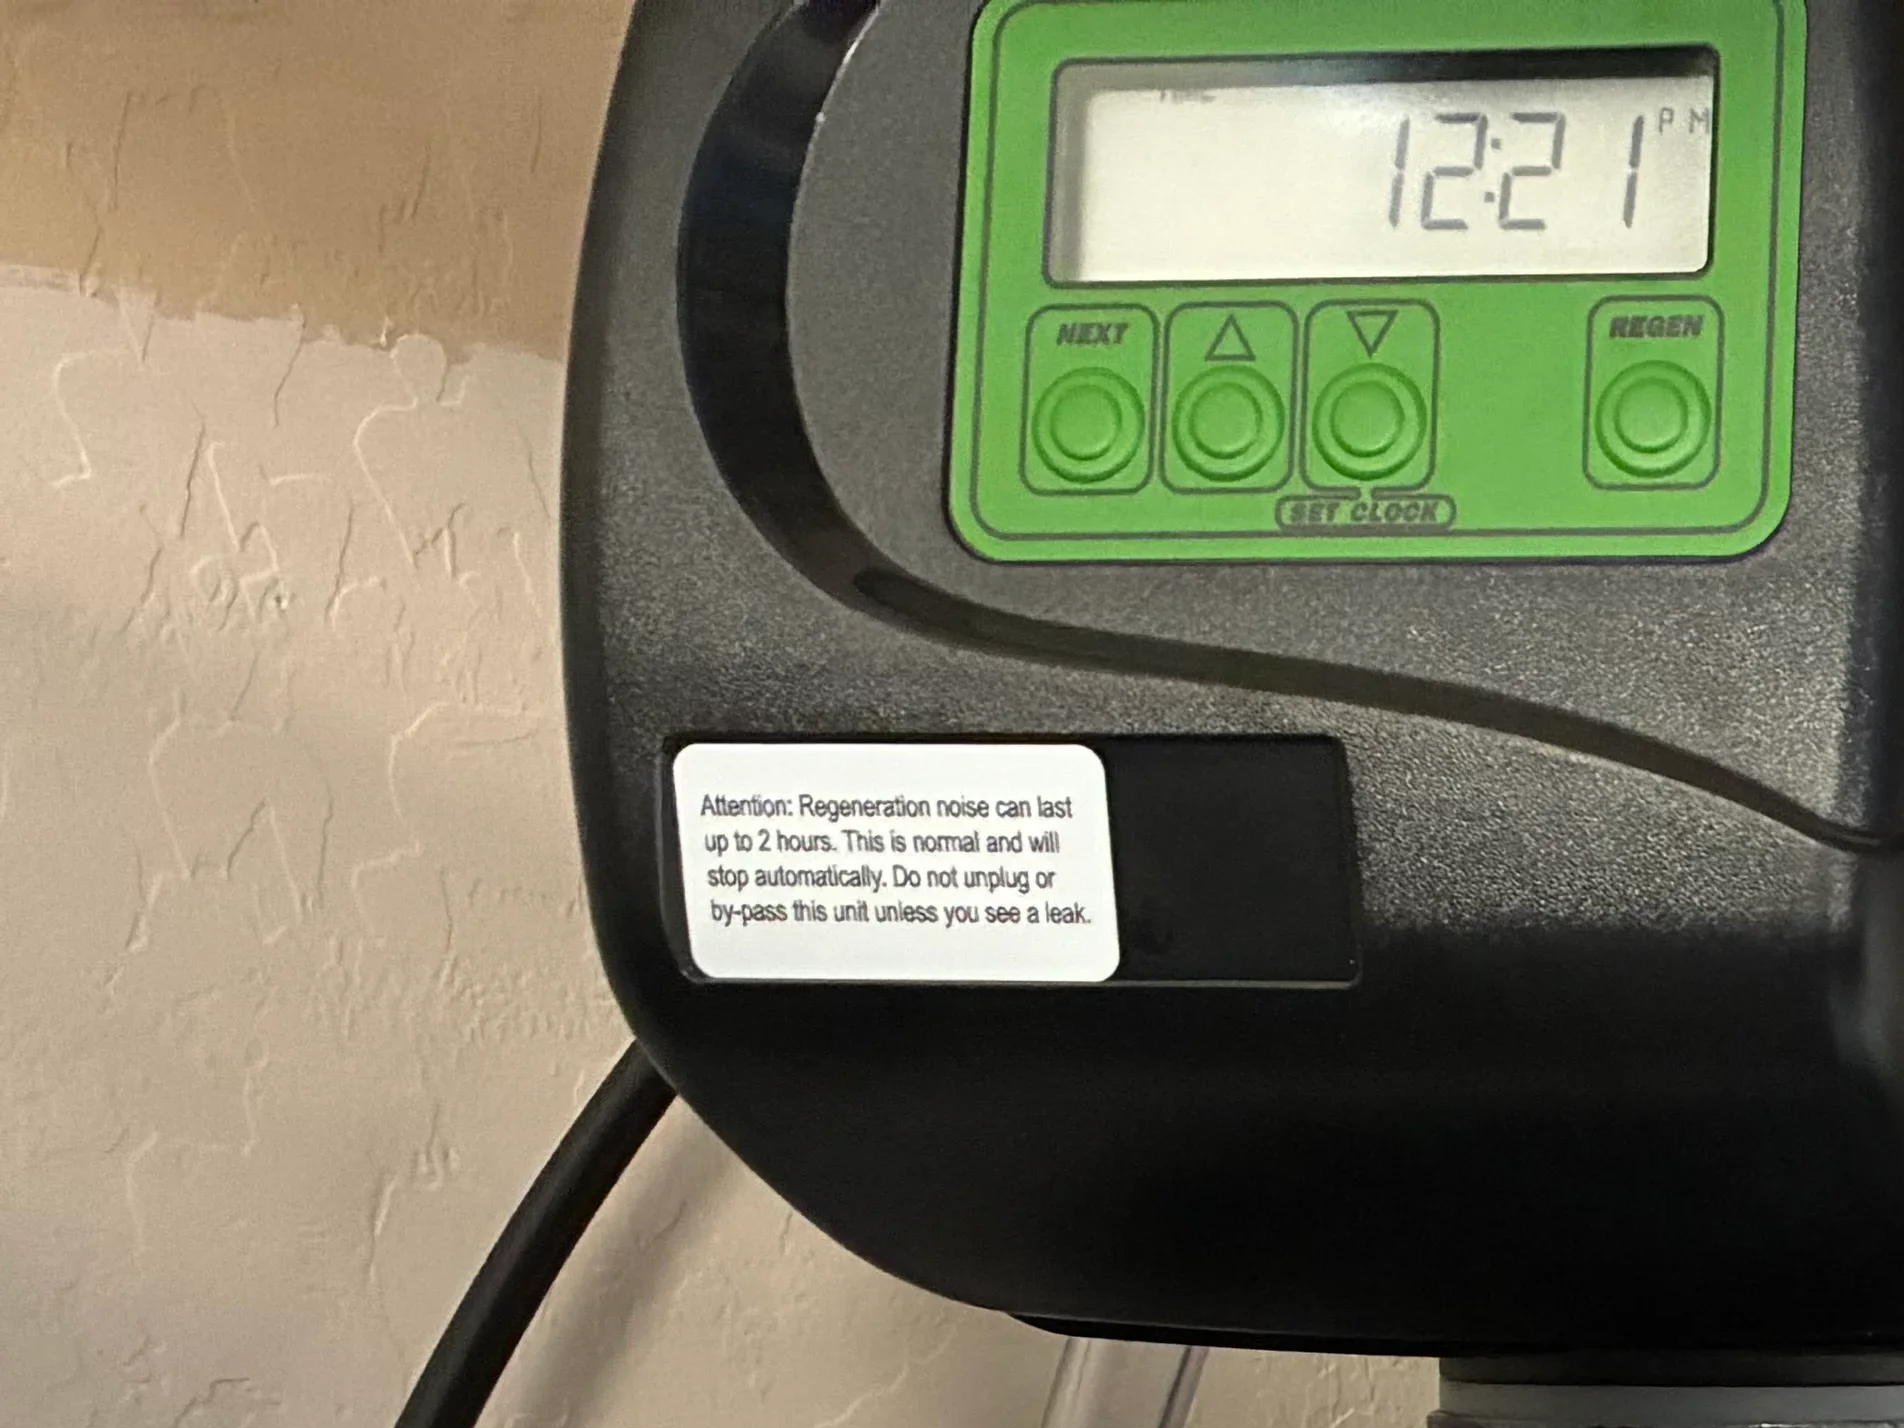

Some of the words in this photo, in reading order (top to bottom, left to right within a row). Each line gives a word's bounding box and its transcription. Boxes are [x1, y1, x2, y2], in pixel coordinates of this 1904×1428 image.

[1389, 111, 1644, 230] 12:21
[1659, 107, 1709, 135] PM
[1056, 322, 1127, 345] NEXT
[1609, 314, 1704, 338] REGEN
[1289, 501, 1341, 524] SET
[1350, 500, 1439, 523] CLOCK
[701, 794, 792, 817] Attention:
[800, 796, 931, 822] Regeneration
[937, 798, 988, 818] noise
[995, 800, 1031, 818] can
[1038, 797, 1072, 819] last
[705, 835, 729, 855] up
[735, 831, 753, 852] to
[758, 831, 771, 852] 2
[777, 830, 836, 852] hours.
[845, 830, 885, 852] This
[891, 832, 907, 852] is
[913, 831, 980, 853] normal
[986, 832, 1022, 853] and
[1029, 832, 1060, 853] will
[708, 868, 749, 891] stop
[754, 865, 888, 892] automatically.
[893, 866, 920, 886] Do
[927, 867, 958, 888] not
[964, 866, 1029, 893] unplug
[1036, 871, 1055, 888] or
[711, 900, 787, 927] by-pass
[793, 901, 828, 923] this
[834, 901, 869, 923] unit
[875, 902, 938, 923] unless
[944, 905, 978, 928] you
[986, 906, 1020, 924] see
[1027, 907, 1039, 924] a
[1046, 902, 1091, 925] leak.
